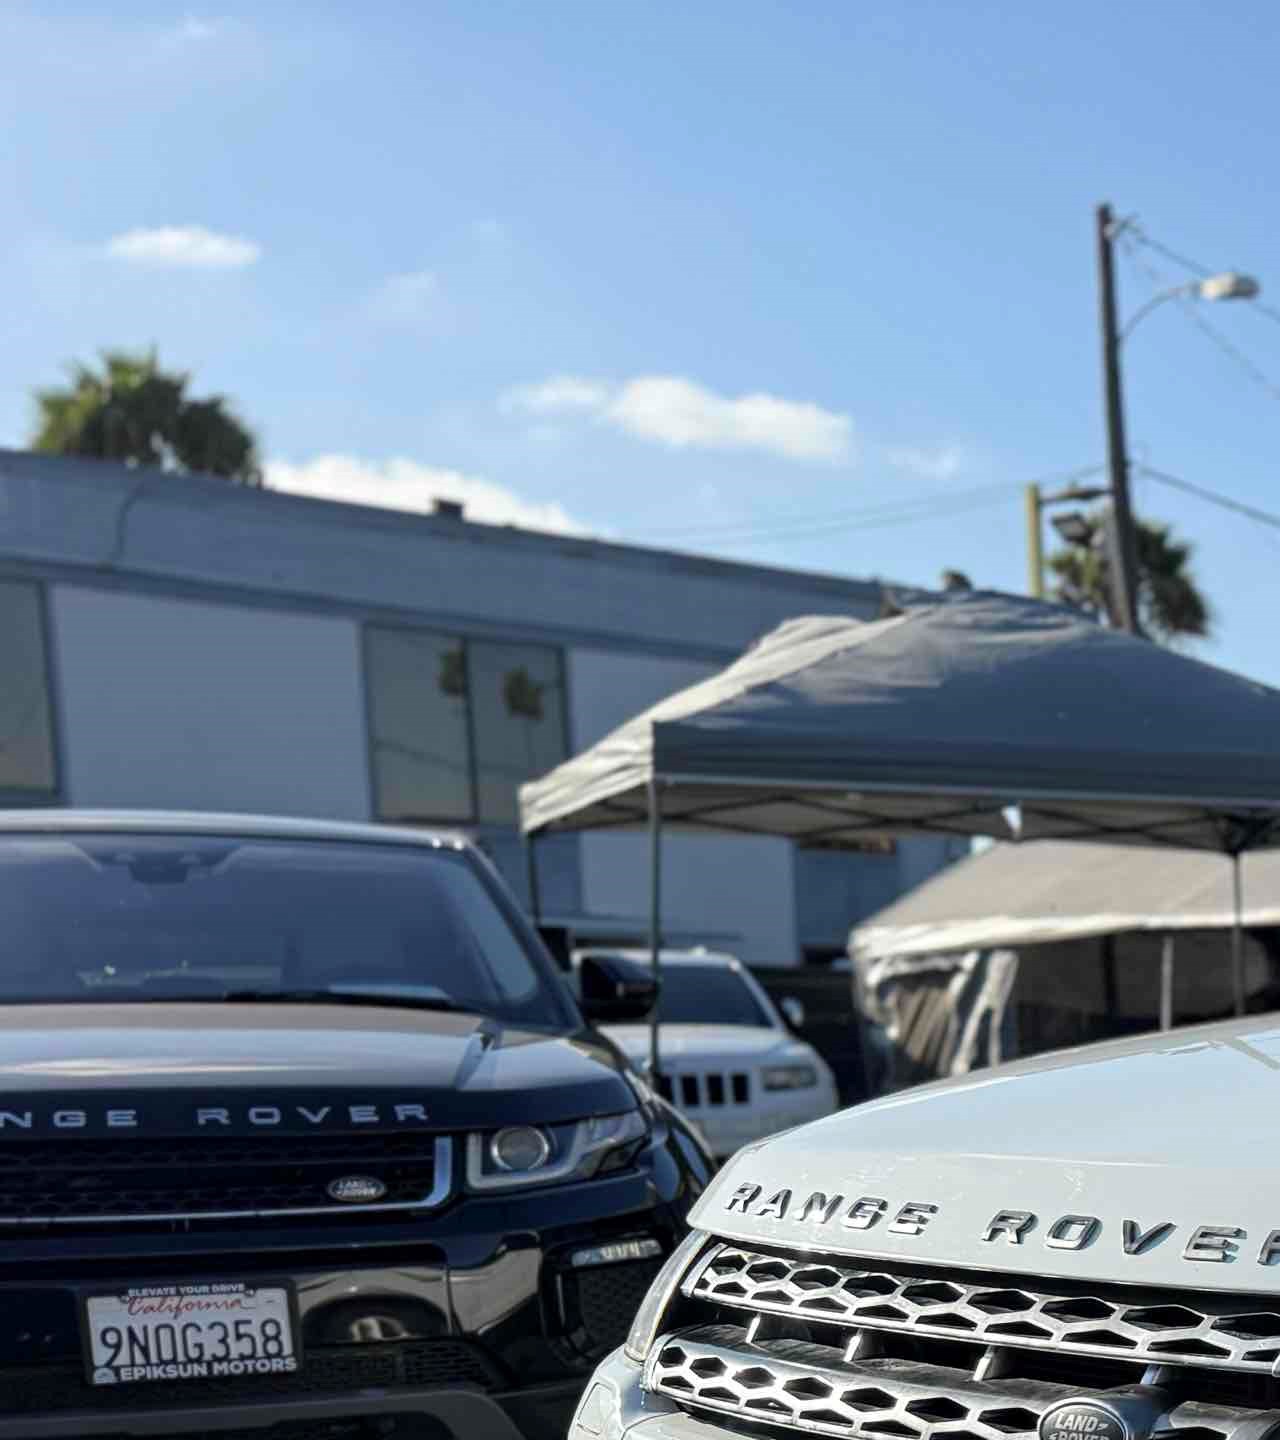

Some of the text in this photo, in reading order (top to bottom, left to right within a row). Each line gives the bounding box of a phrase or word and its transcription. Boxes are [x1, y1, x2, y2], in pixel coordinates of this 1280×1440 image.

[196, 1104, 428, 1125] ROVER
[726, 1182, 940, 1235] RANGE
[128, 1284, 245, 1297] ELEVATE YOUR DRIVE
[127, 1293, 250, 1320] California
[120, 1357, 297, 1381] EPIKSUN MOTORS
[1055, 1411, 1099, 1432] LAND
